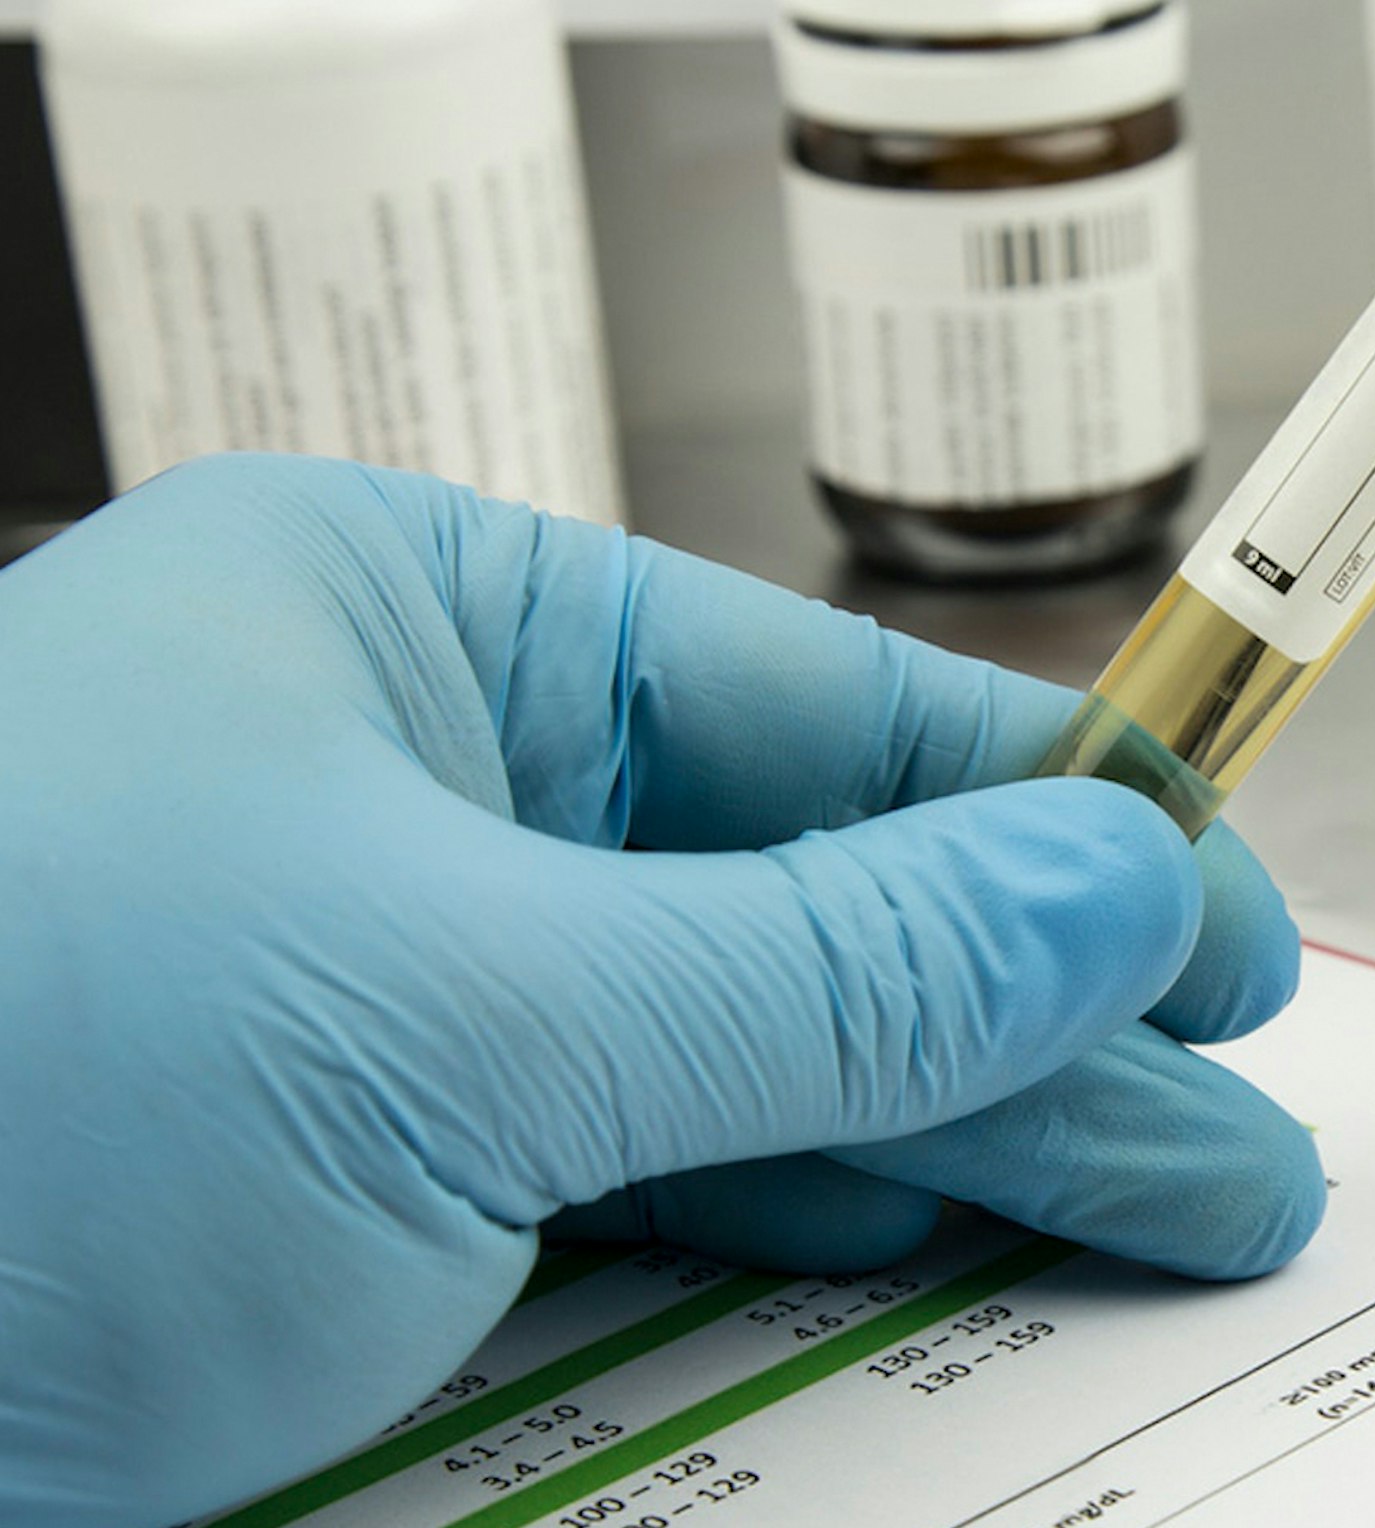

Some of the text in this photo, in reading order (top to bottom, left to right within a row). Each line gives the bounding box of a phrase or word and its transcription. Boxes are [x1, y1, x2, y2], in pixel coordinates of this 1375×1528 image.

[1244, 549, 1282, 583] 9 ml
[747, 1299, 804, 1327] 5.1
[793, 1313, 844, 1343] 4.6
[867, 1277, 922, 1306] 6.5
[867, 1345, 929, 1380] 130
[952, 1304, 1014, 1340] 159
[441, 1375, 488, 1398] 59
[910, 1362, 972, 1397] 130
[996, 1320, 1057, 1356] 159
[443, 1444, 499, 1475] 4.1
[523, 1403, 583, 1435] 5.0
[481, 1461, 541, 1493] 3.4
[570, 1419, 625, 1452] 4.5
[560, 1497, 626, 1528] 100
[653, 1452, 718, 1485] 129
[697, 1470, 761, 1503] 129
